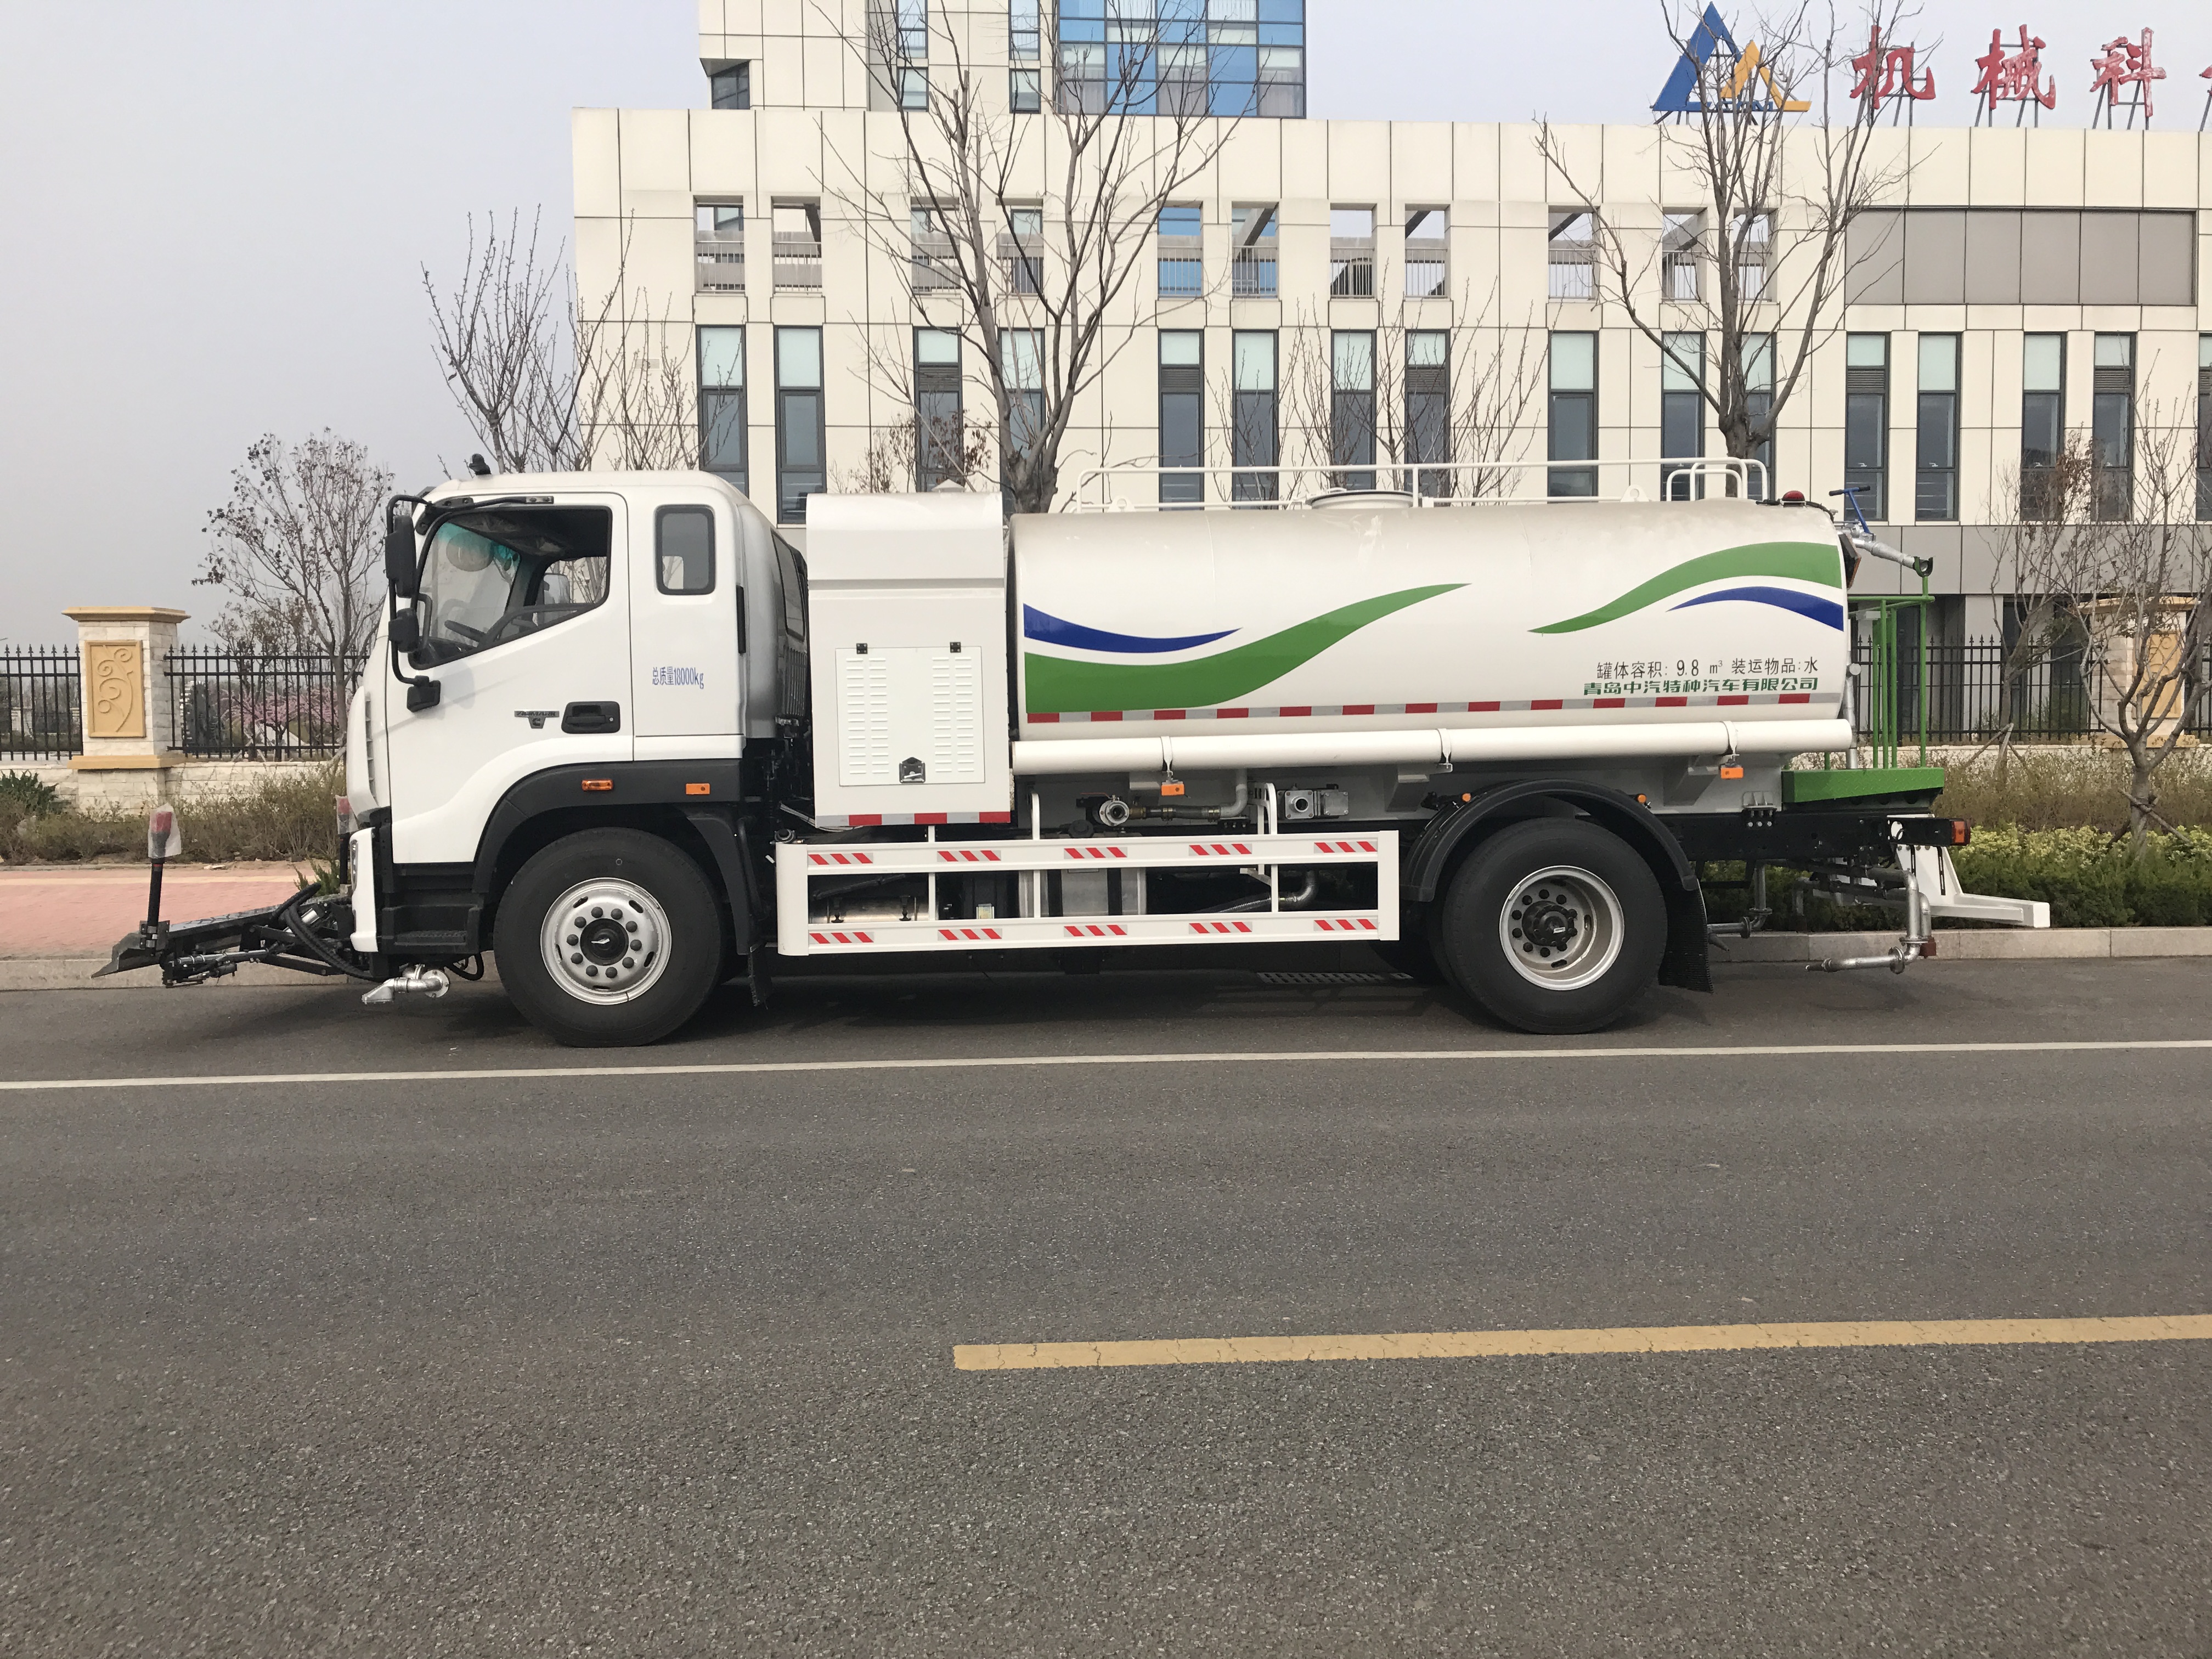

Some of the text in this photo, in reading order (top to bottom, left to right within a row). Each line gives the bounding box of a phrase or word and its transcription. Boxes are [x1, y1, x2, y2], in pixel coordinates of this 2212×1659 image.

[1850, 24, 2212, 117] 机械科
[652, 666, 704, 690] 总质量18000kg
[1596, 661, 1668, 680] 罐体容积:
[1677, 659, 1699, 676] 9.8
[1583, 677, 1818, 696] 青岛中汽特种汽车有限公司
